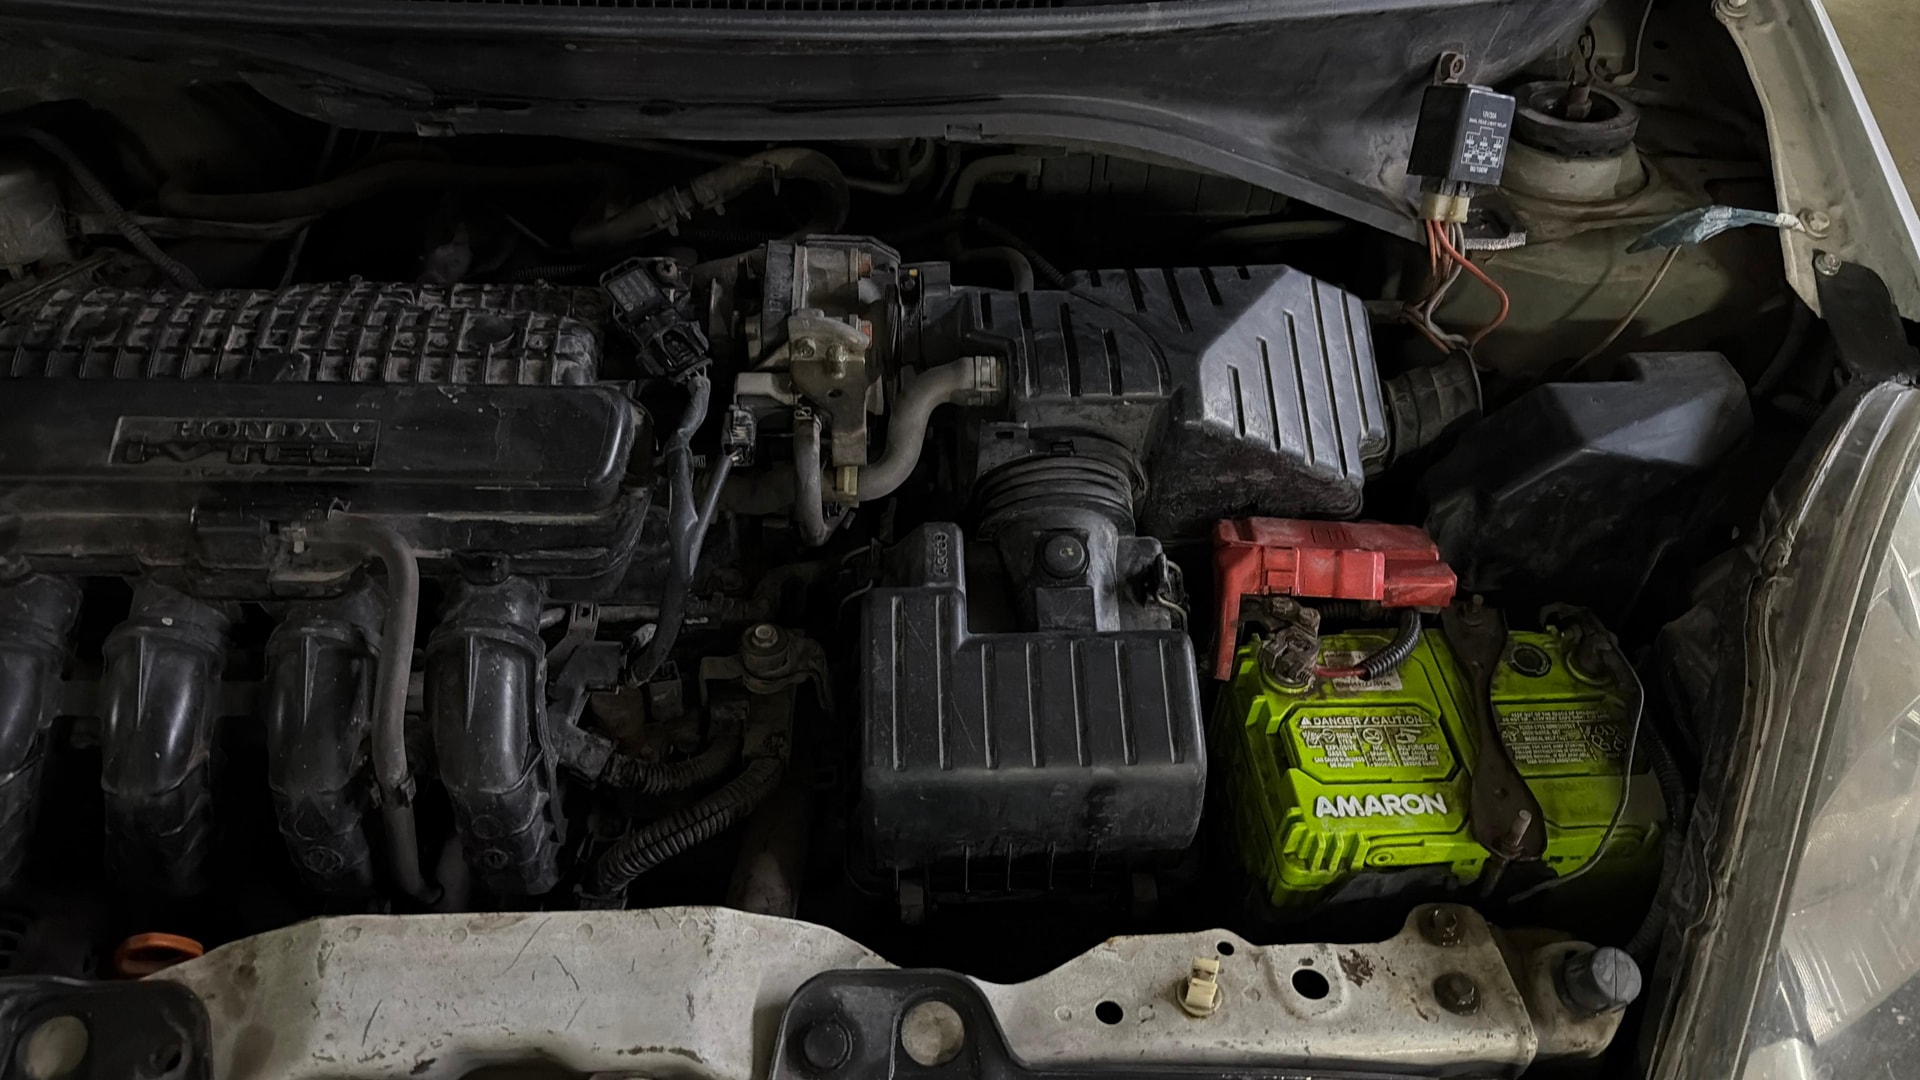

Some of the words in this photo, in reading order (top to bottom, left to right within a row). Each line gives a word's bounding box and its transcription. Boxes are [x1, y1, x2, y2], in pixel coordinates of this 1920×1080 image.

[176, 421, 339, 440] HONDA
[1313, 716, 1361, 726] DANGER
[1371, 715, 1422, 725] CAUTION
[1315, 792, 1448, 818] AMARON
